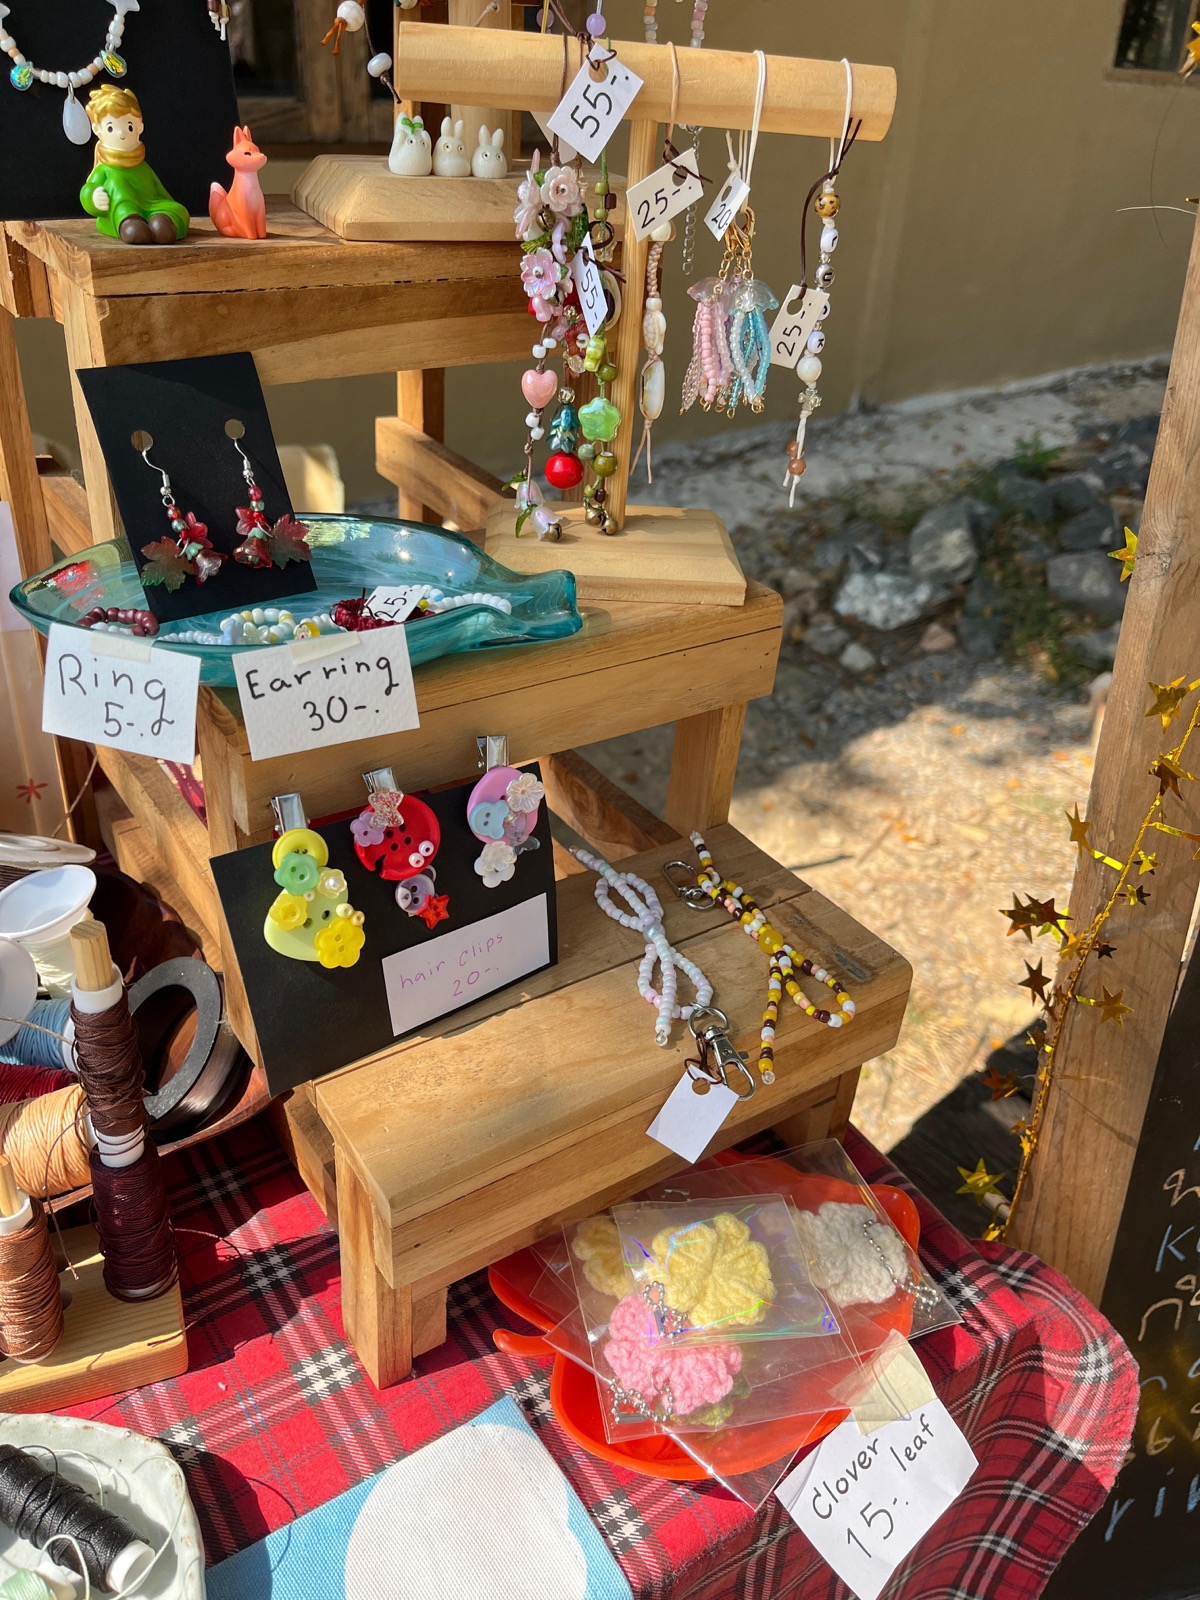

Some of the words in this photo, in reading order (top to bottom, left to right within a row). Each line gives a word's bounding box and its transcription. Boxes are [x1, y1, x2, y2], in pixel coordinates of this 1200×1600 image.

[58, 653, 174, 737] Ring
[245, 655, 399, 699] Earring
[399, 961, 445, 989] hair
[812, 1437, 879, 1519] Clover
[889, 1413, 934, 1472] leaf
